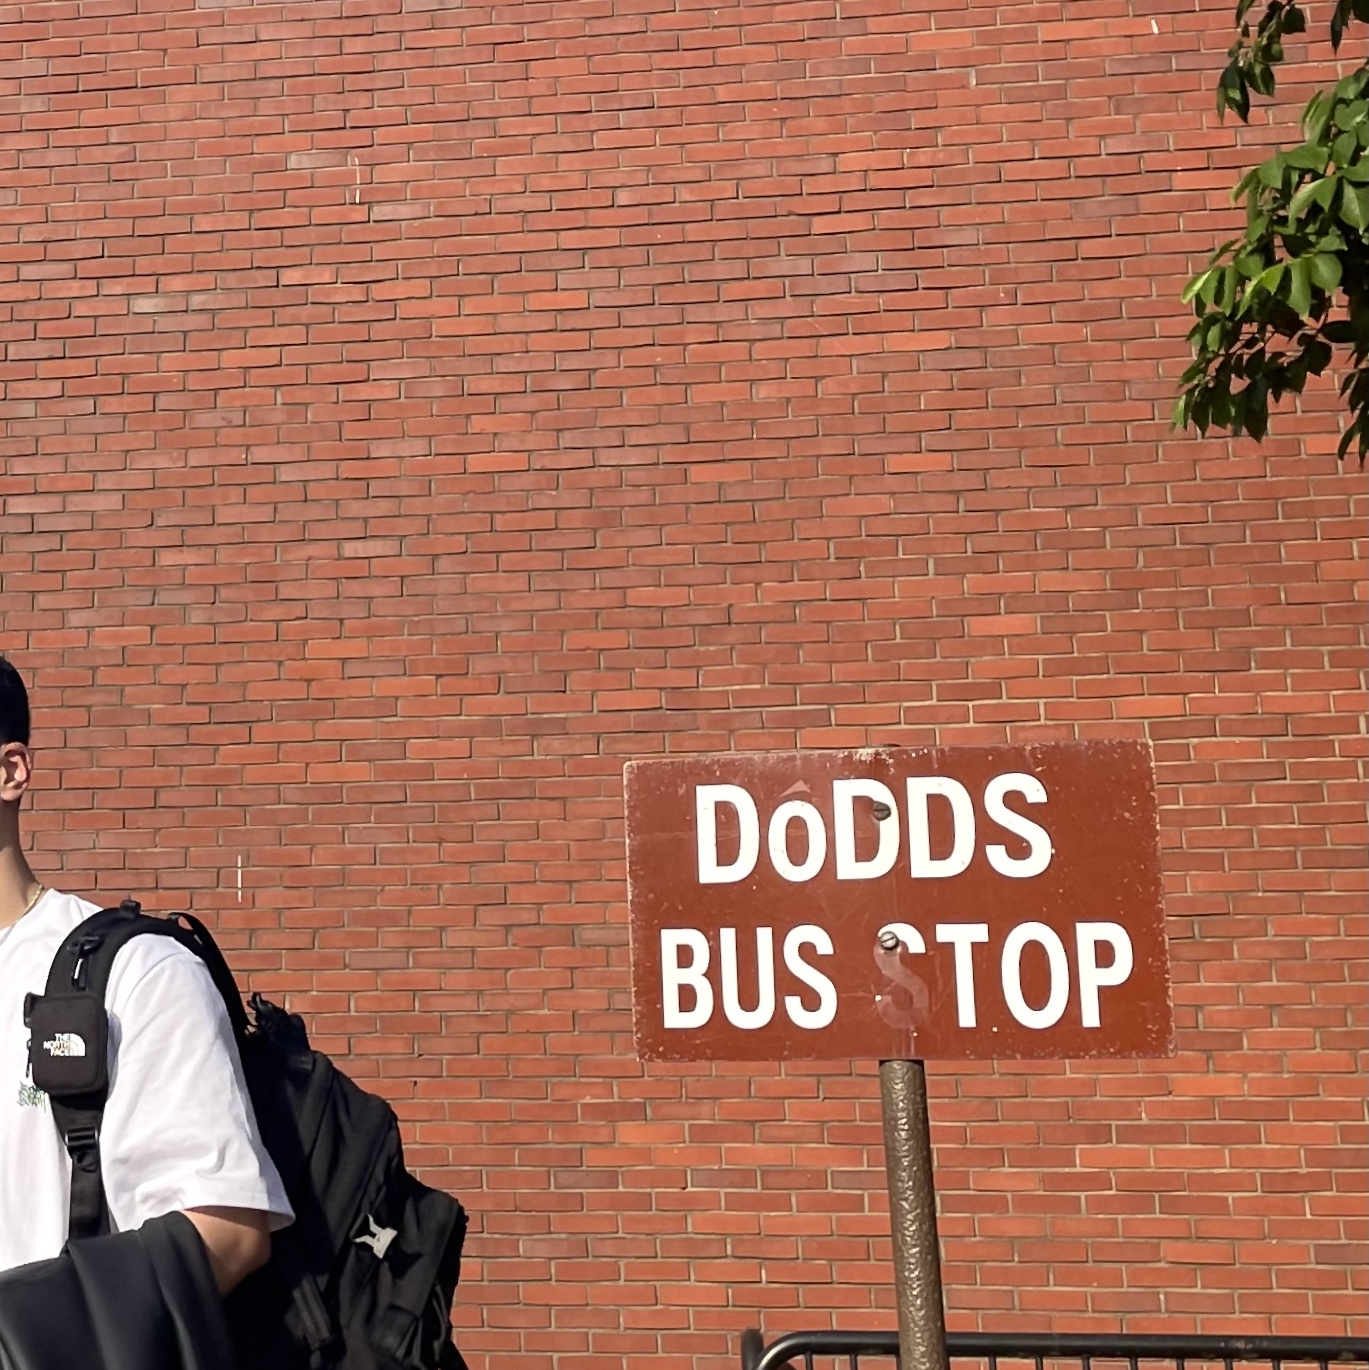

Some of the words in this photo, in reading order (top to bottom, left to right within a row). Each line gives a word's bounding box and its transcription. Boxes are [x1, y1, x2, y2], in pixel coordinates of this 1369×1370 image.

[695, 772, 1056, 884] DoDDS
[660, 924, 838, 1030] BUS
[874, 921, 1133, 1029] STOP
